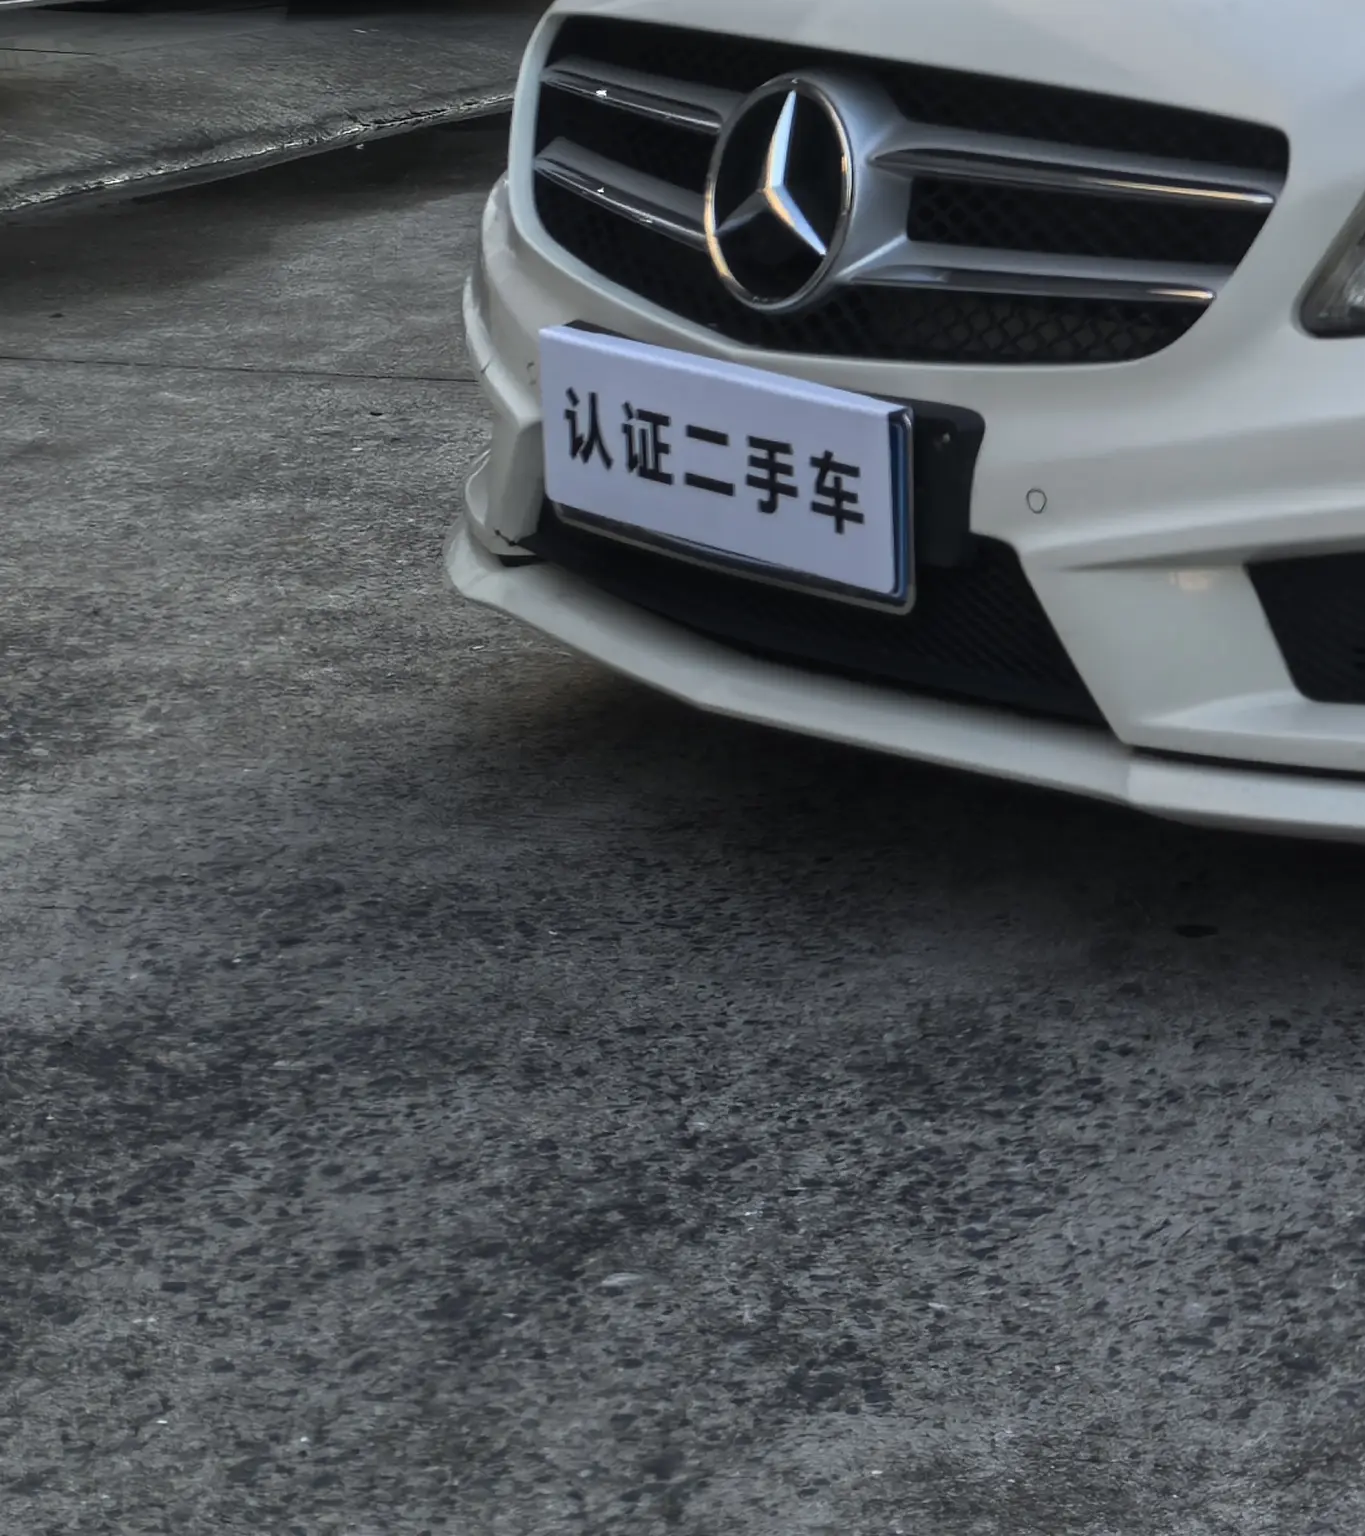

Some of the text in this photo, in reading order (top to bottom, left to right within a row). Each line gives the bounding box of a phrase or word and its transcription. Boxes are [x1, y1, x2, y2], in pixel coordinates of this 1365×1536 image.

[564, 386, 865, 536] 认证二手车
